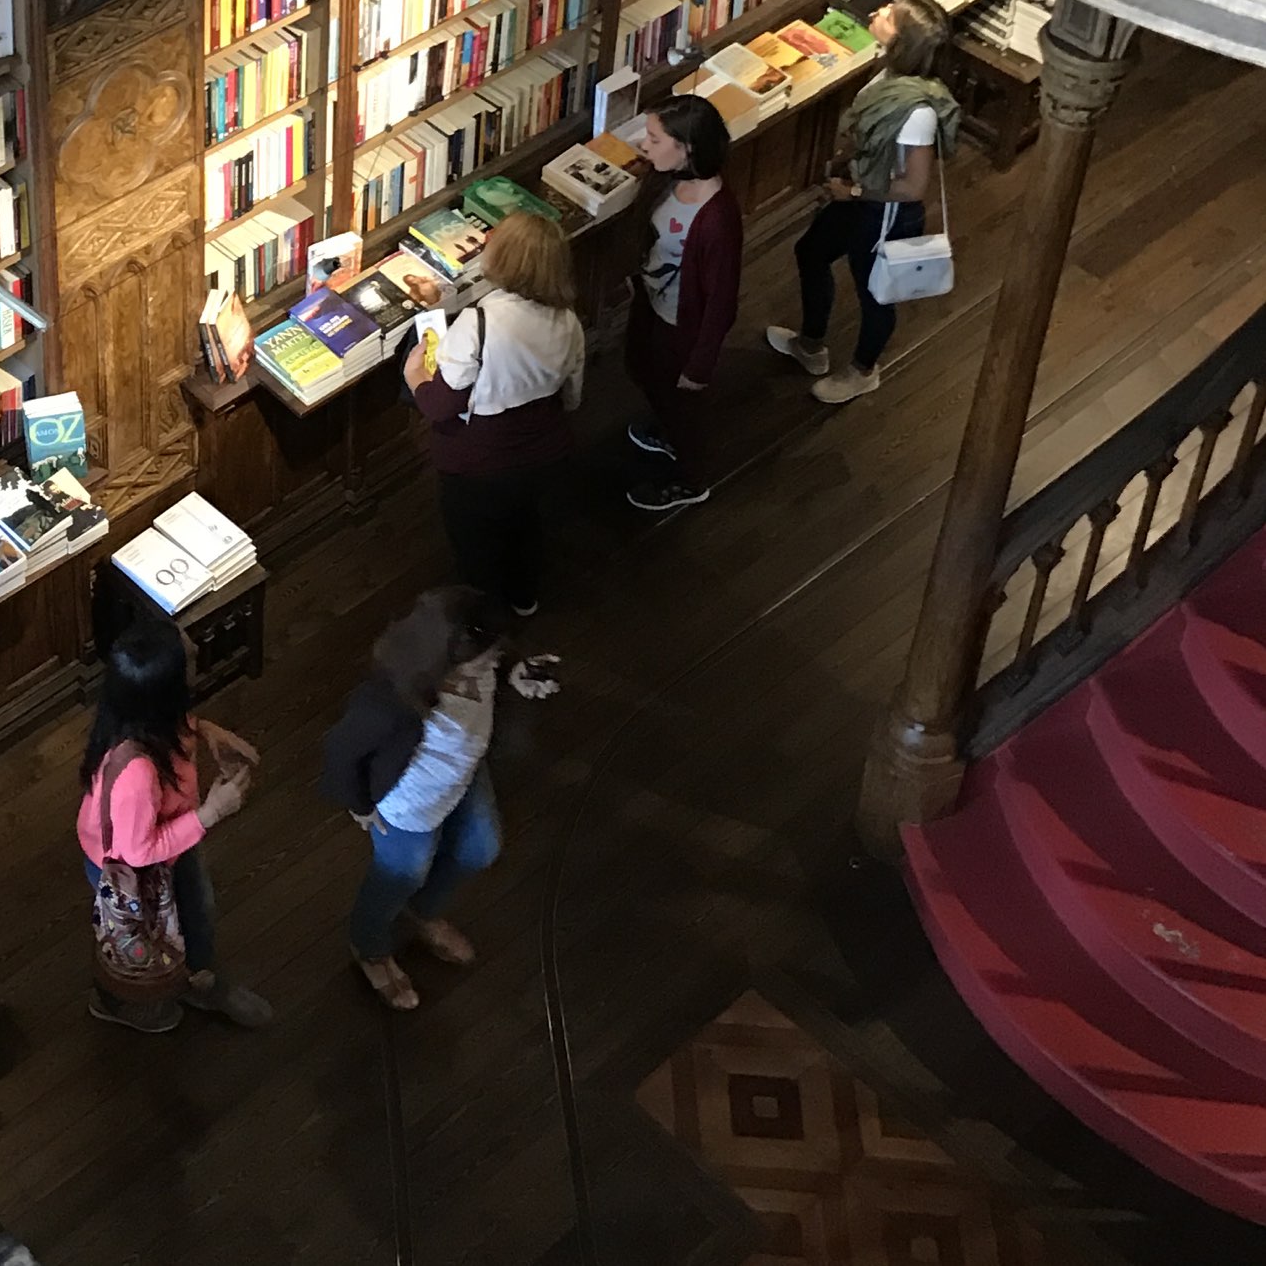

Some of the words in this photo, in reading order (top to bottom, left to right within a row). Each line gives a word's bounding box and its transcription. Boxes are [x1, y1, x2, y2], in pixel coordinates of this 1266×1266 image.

[262, 323, 303, 350] YANN
[271, 330, 310, 356] MARTEL
[28, 413, 84, 446] OZ
